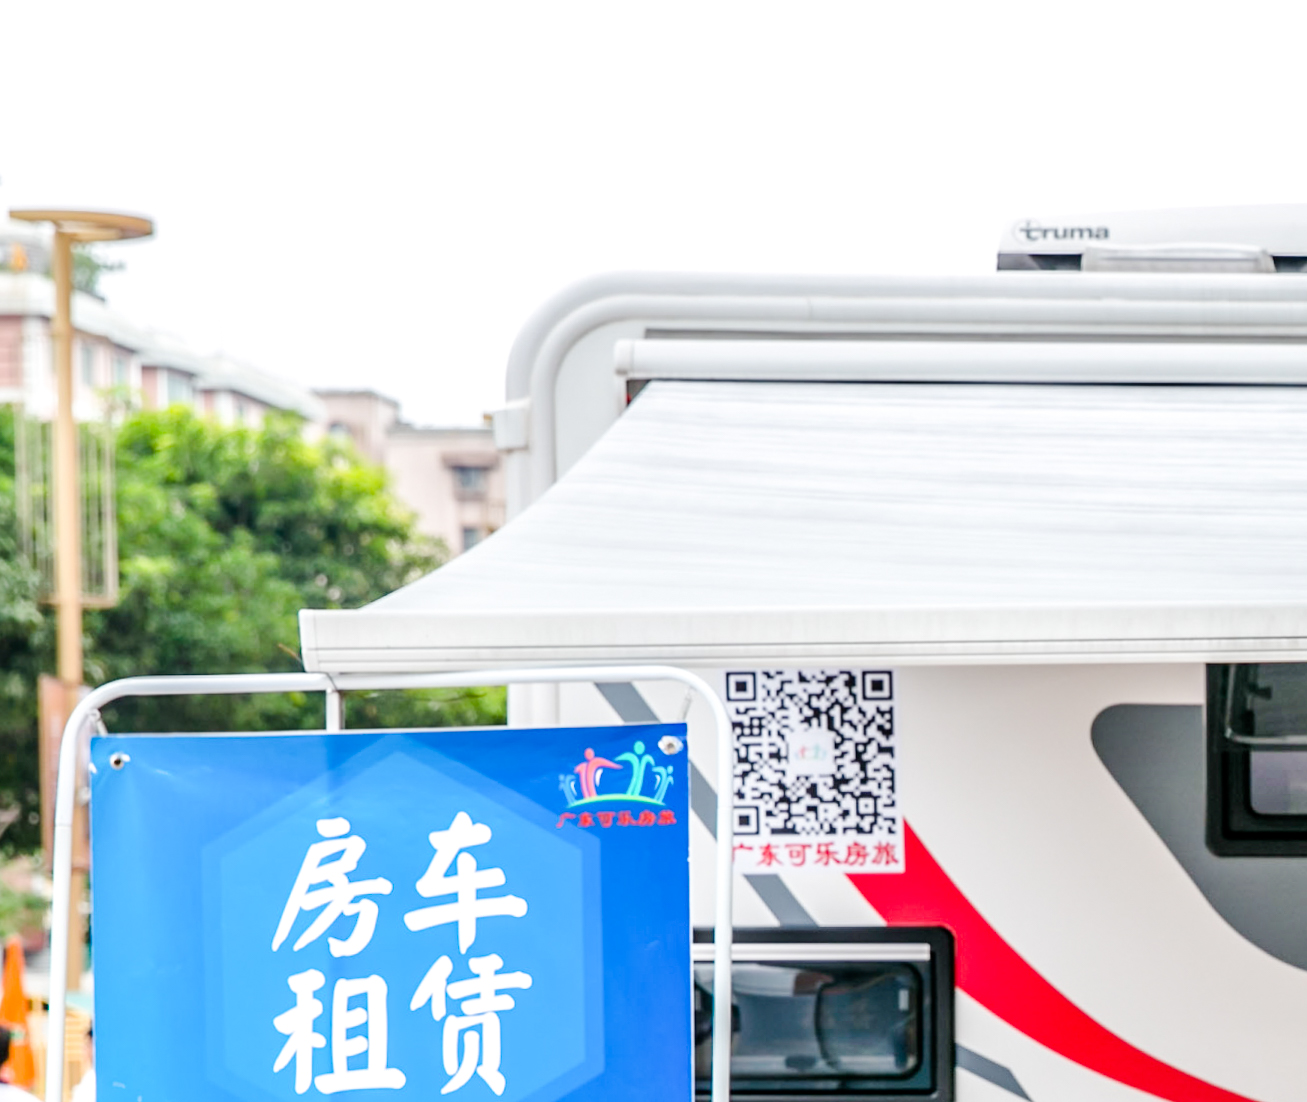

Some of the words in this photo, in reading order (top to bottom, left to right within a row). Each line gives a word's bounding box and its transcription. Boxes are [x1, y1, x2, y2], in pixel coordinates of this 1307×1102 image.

[1019, 219, 1110, 241] truma
[272, 812, 528, 957] 房车
[273, 954, 532, 1096] 租赁
